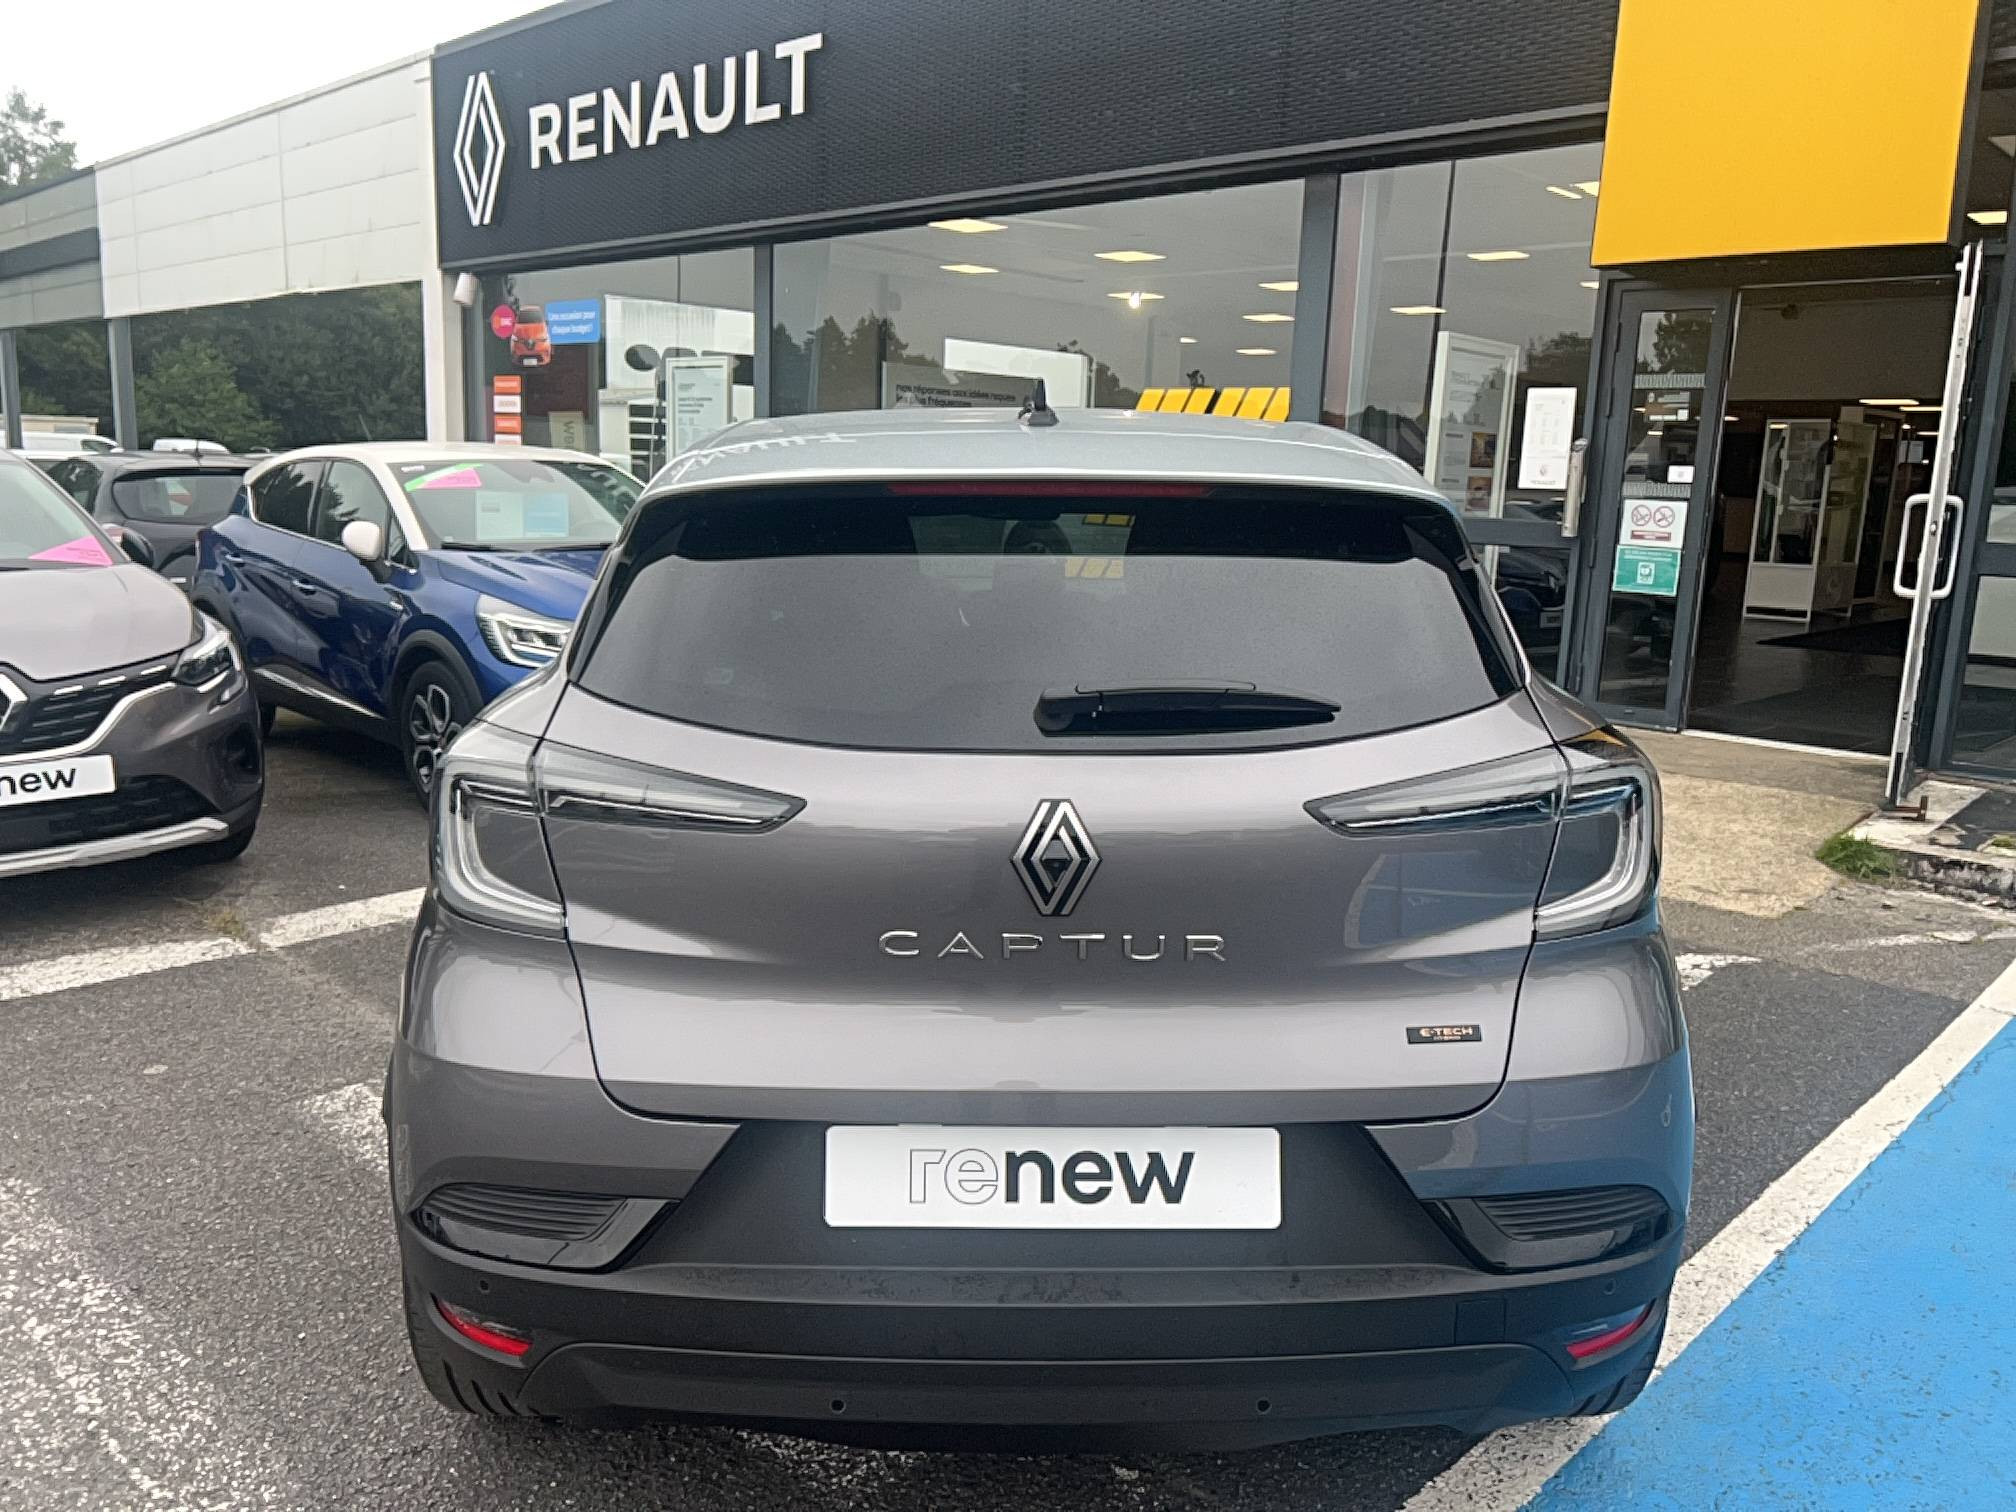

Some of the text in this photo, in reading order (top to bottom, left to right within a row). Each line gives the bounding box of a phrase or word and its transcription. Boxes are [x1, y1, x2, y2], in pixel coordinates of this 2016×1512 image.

[528, 32, 824, 170] RENAULT
[879, 930, 1227, 961] CAPTUR
[909, 1148, 1195, 1204] renew
